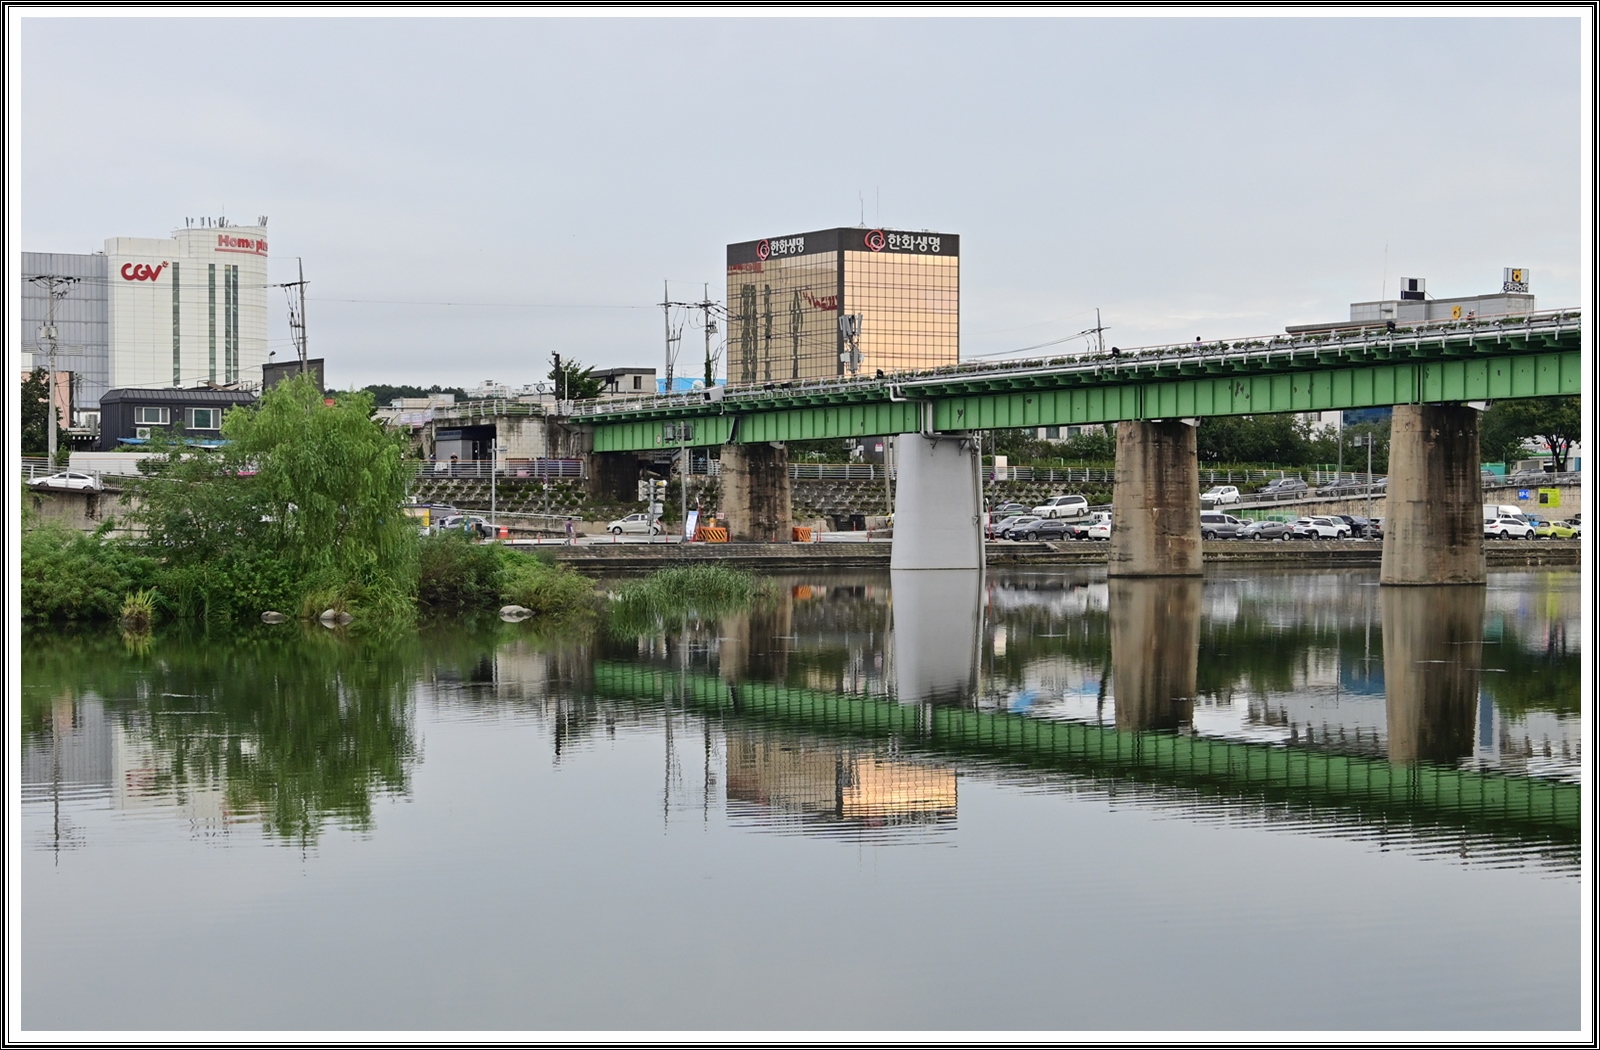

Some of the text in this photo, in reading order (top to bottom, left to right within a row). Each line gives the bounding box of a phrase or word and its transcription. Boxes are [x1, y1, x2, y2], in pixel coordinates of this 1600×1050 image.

[218, 234, 255, 249] Home
[770, 237, 805, 256] 한화생명
[888, 233, 941, 253] 한화생명
[121, 263, 163, 282] CGV
